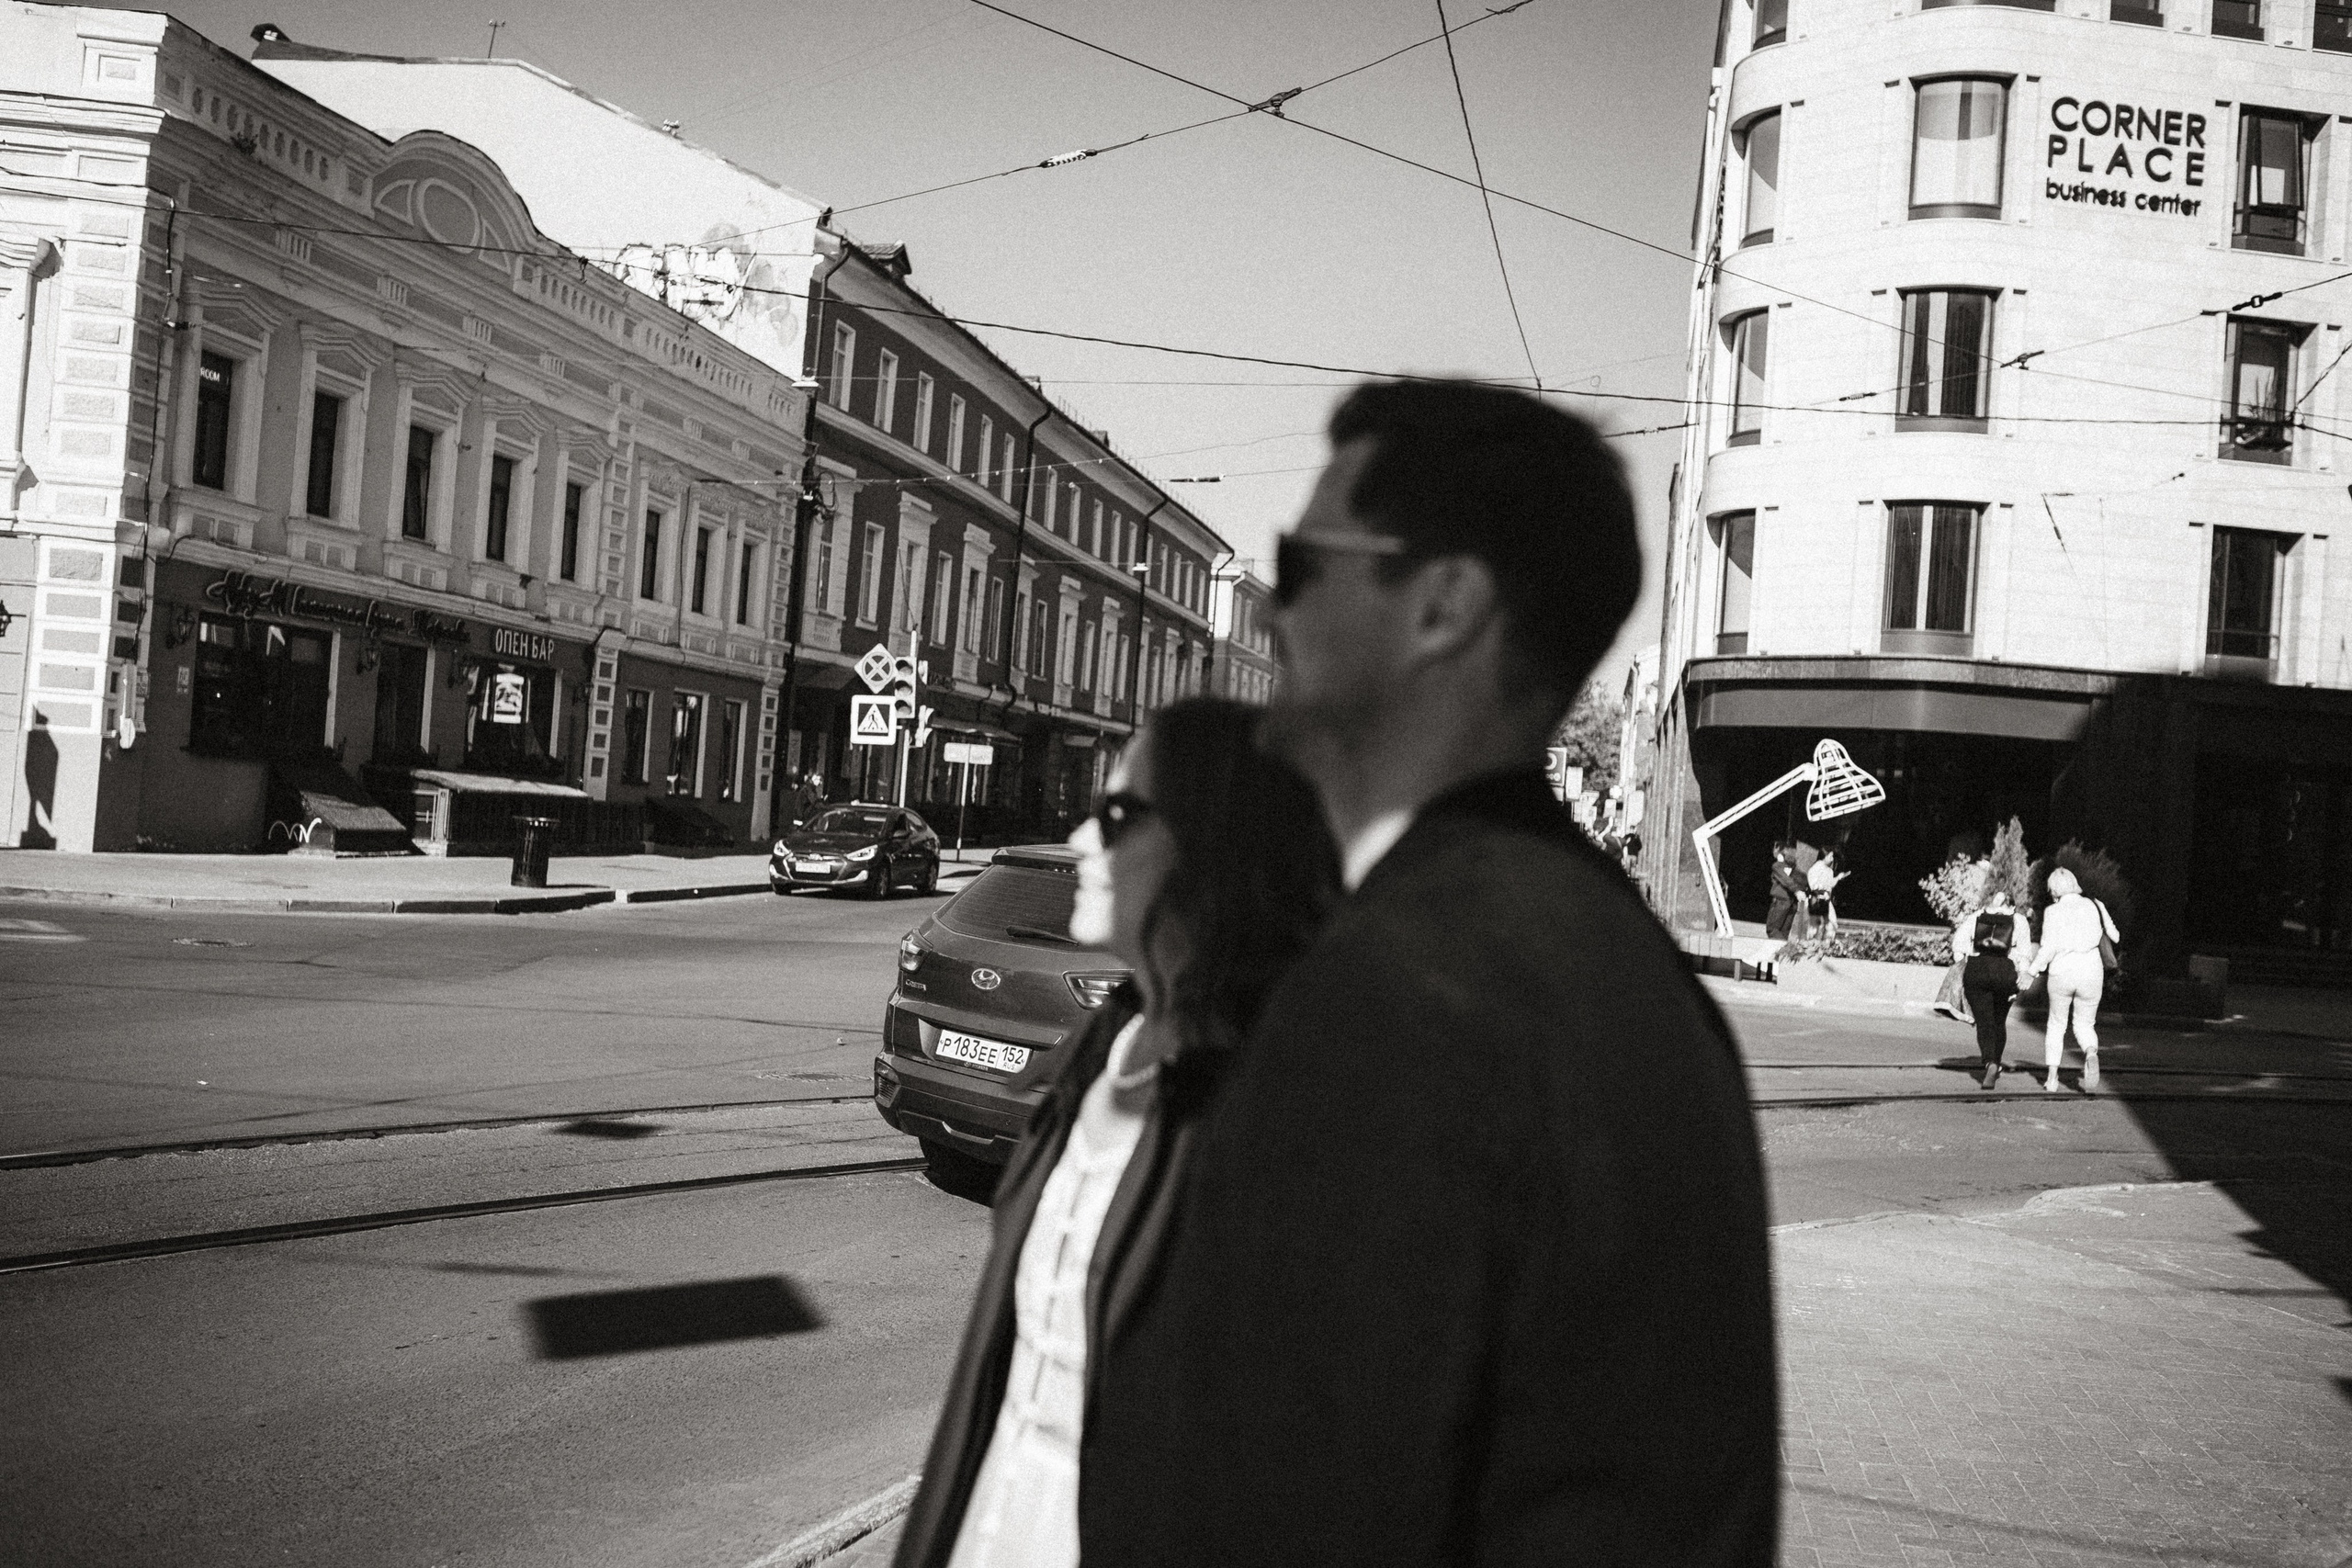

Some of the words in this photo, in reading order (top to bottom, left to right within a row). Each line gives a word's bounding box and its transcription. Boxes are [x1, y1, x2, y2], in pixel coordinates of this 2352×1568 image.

[2051, 96, 2206, 149] CORNER
[2047, 134, 2205, 186] PLACE
[2046, 177, 2127, 208] business
[2134, 193, 2201, 216] center
[495, 628, 528, 657] ОПЕН
[532, 636, 554, 660] БАР
[1002, 1046, 1023, 1065] 152
[1002, 1063, 1015, 1071] RUS
